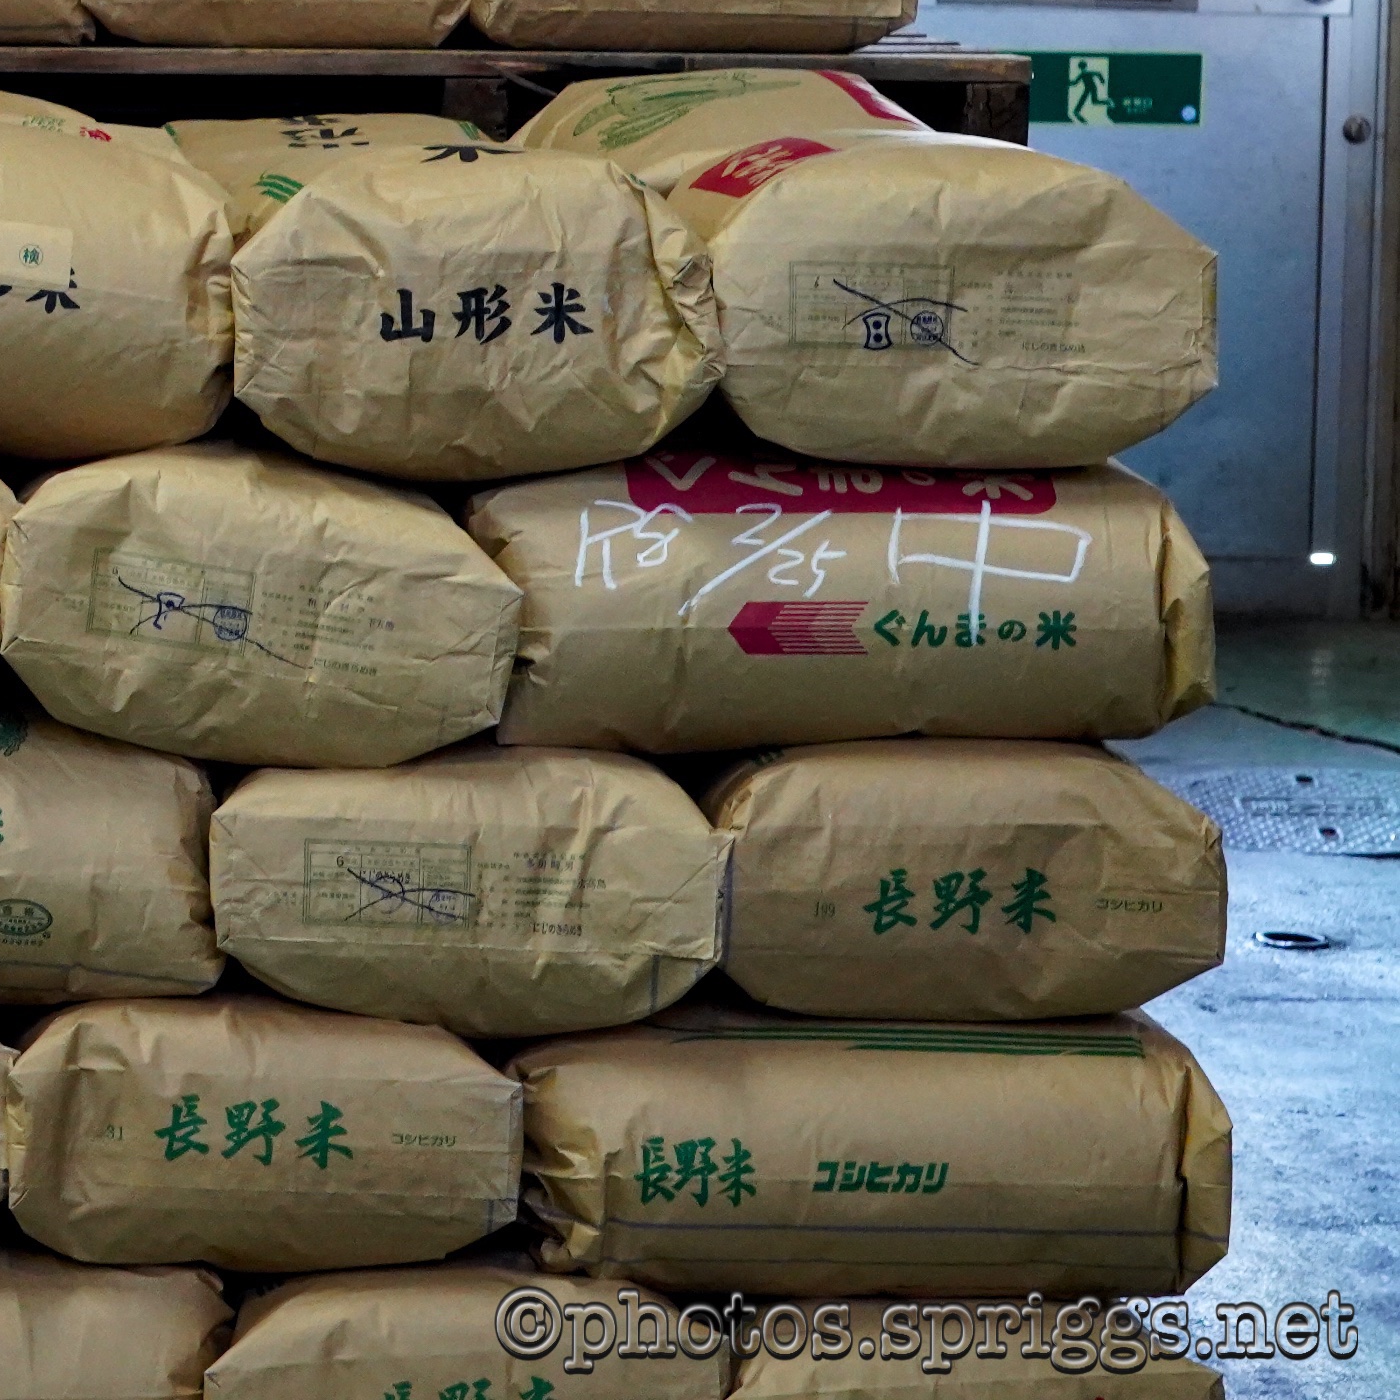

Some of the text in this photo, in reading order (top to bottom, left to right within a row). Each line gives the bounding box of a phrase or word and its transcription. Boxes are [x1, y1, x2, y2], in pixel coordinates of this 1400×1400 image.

[19, 242, 45, 268] 検
[378, 282, 594, 346] 山形米
[873, 608, 1080, 650] ぐんまの米
[863, 868, 1058, 936] 長野米
[1095, 897, 1165, 914] コシヒカリ
[155, 1094, 355, 1169] 長野米
[390, 1130, 457, 1148] コシヒカリ
[636, 1135, 950, 1208] 長野米 コシヒカリ
